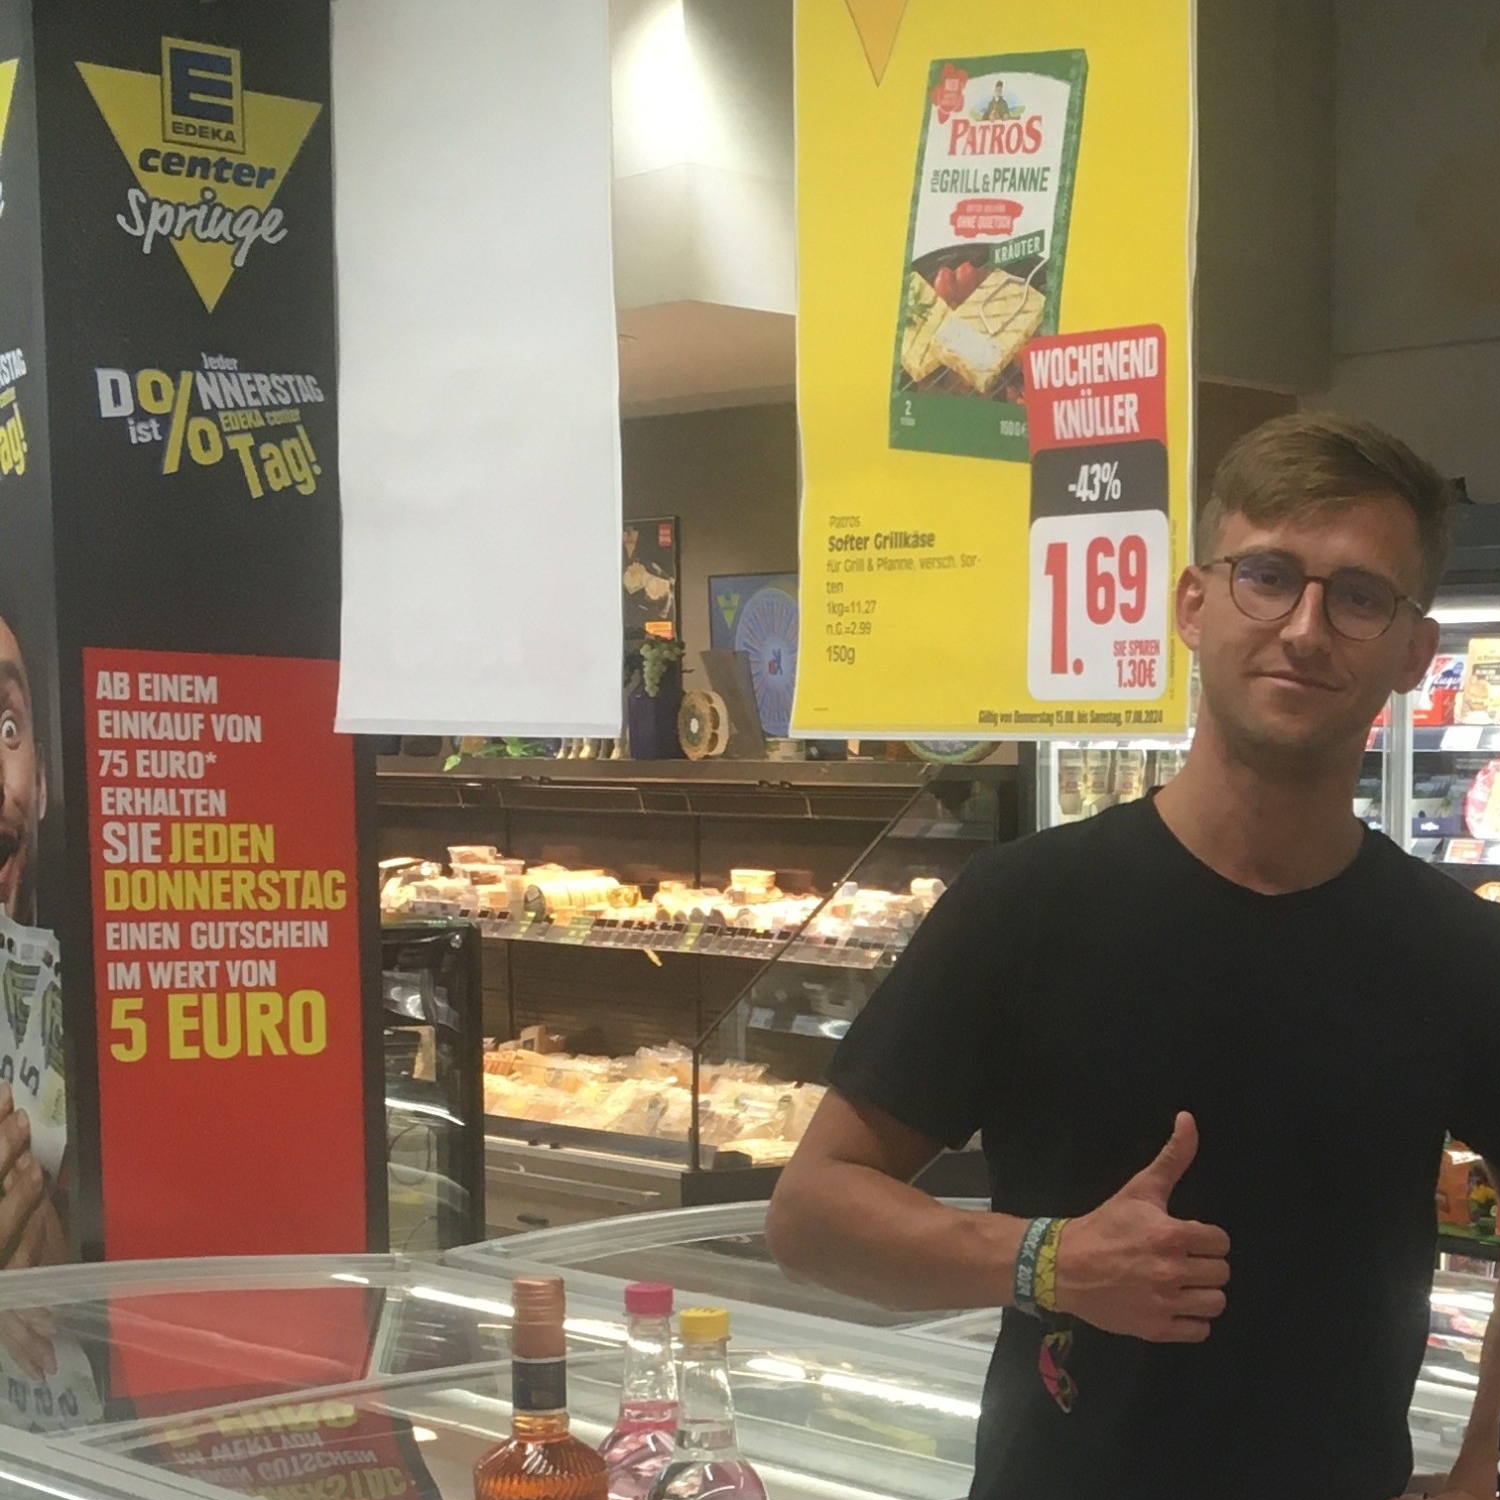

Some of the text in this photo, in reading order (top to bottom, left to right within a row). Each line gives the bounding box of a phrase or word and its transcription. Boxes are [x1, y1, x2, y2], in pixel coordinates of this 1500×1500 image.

[171, 121, 237, 143] EDEKA
[947, 115, 1043, 156] PATROS
[138, 148, 276, 189] center
[940, 168, 980, 193] GRILL
[991, 166, 1051, 193] PFANNE
[994, 236, 1041, 264] KRÄUTER
[1030, 336, 1159, 390] WOCHENEND
[127, 417, 162, 444] ist
[218, 409, 266, 432] EDEKA
[1053, 389, 1140, 441] KNÜLLER
[225, 424, 322, 499] Tag!
[1067, 460, 1122, 502] -43%
[829, 515, 861, 529] Patros
[828, 530, 936, 553] Softer Grillkäse
[826, 559, 841, 573] für
[844, 558, 864, 573] Grill
[867, 557, 874, 572] &
[826, 581, 844, 595] ten
[826, 645, 856, 665] 150g
[1113, 639, 1161, 657] SIE SPAREN
[96, 671, 218, 704] AB EINEM
[1116, 658, 1157, 689] 1.30€
[97, 709, 262, 743] EINKAUF VON
[98, 749, 129, 778] 75
[100, 786, 227, 817] ERHALTEN
[102, 821, 275, 864] SIE JEDEN
[104, 869, 347, 911] DONNERSTAG
[105, 920, 329, 950] EINEN GUTSCHEIN
[107, 959, 277, 990] IM WERT VON
[110, 989, 327, 1063] 5 EURO
